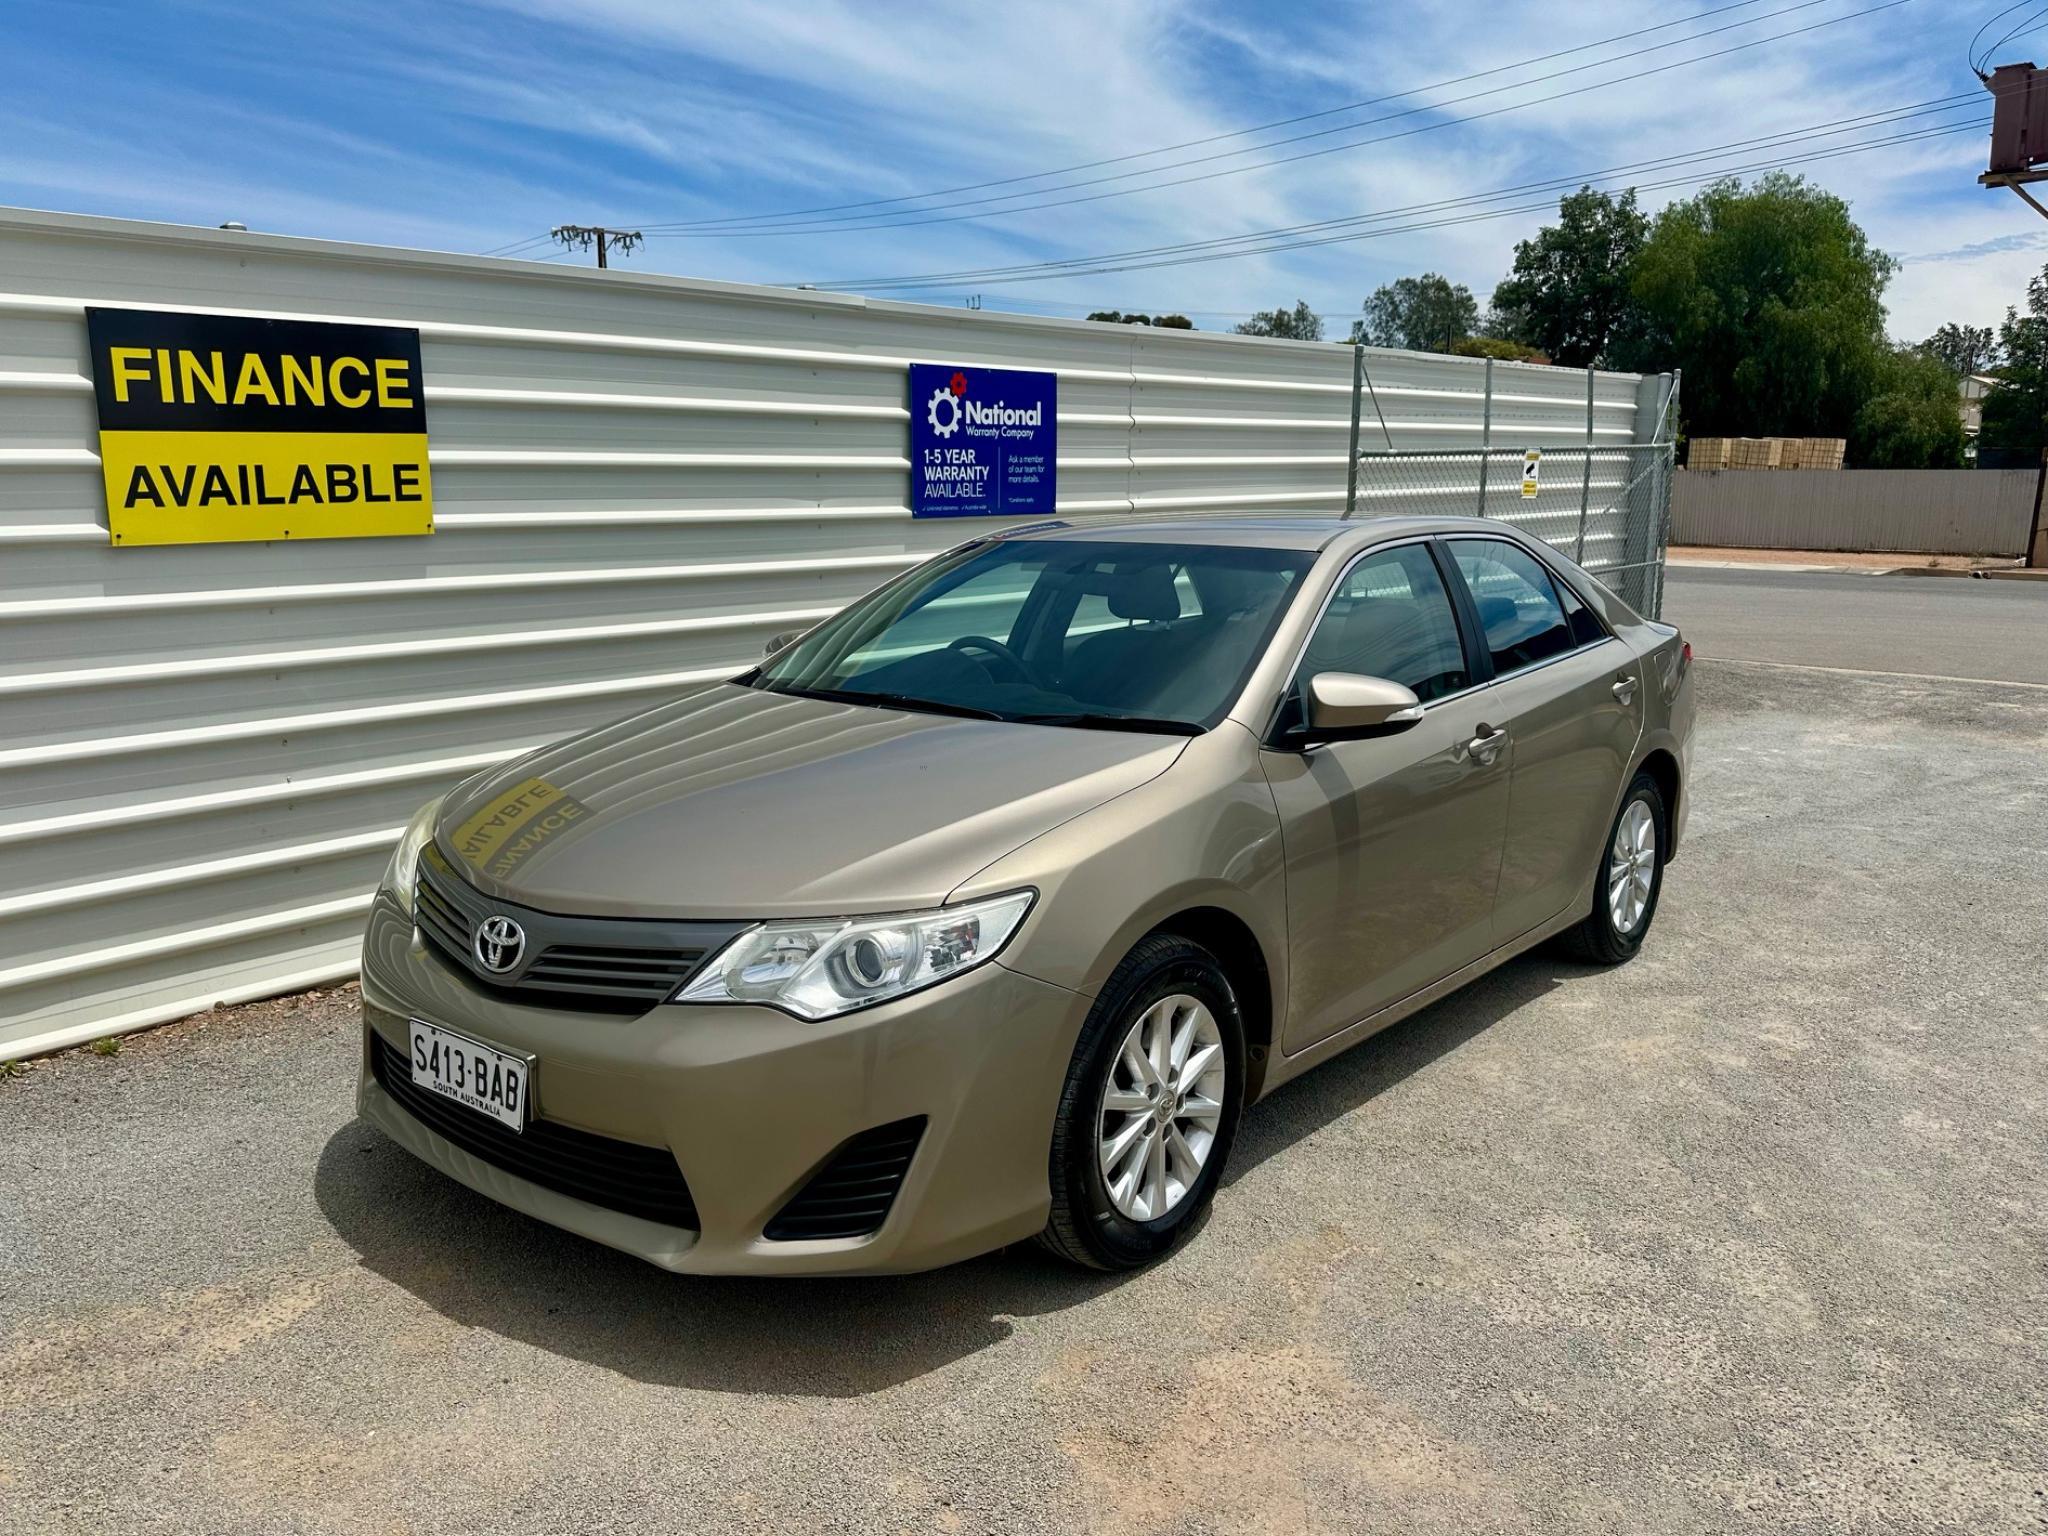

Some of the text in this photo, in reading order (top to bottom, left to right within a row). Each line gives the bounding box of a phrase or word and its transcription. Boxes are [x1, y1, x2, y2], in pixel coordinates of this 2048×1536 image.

[110, 347, 414, 408] FINANCE
[965, 400, 1042, 426] National
[965, 425, 1034, 440] Warranty Company
[924, 449, 976, 464] 1-5 YEAR
[124, 464, 423, 508] AVAILABLE
[924, 466, 989, 481] WARRANTY
[433, 1080, 502, 1117] SOUTH AUSTRALIA
